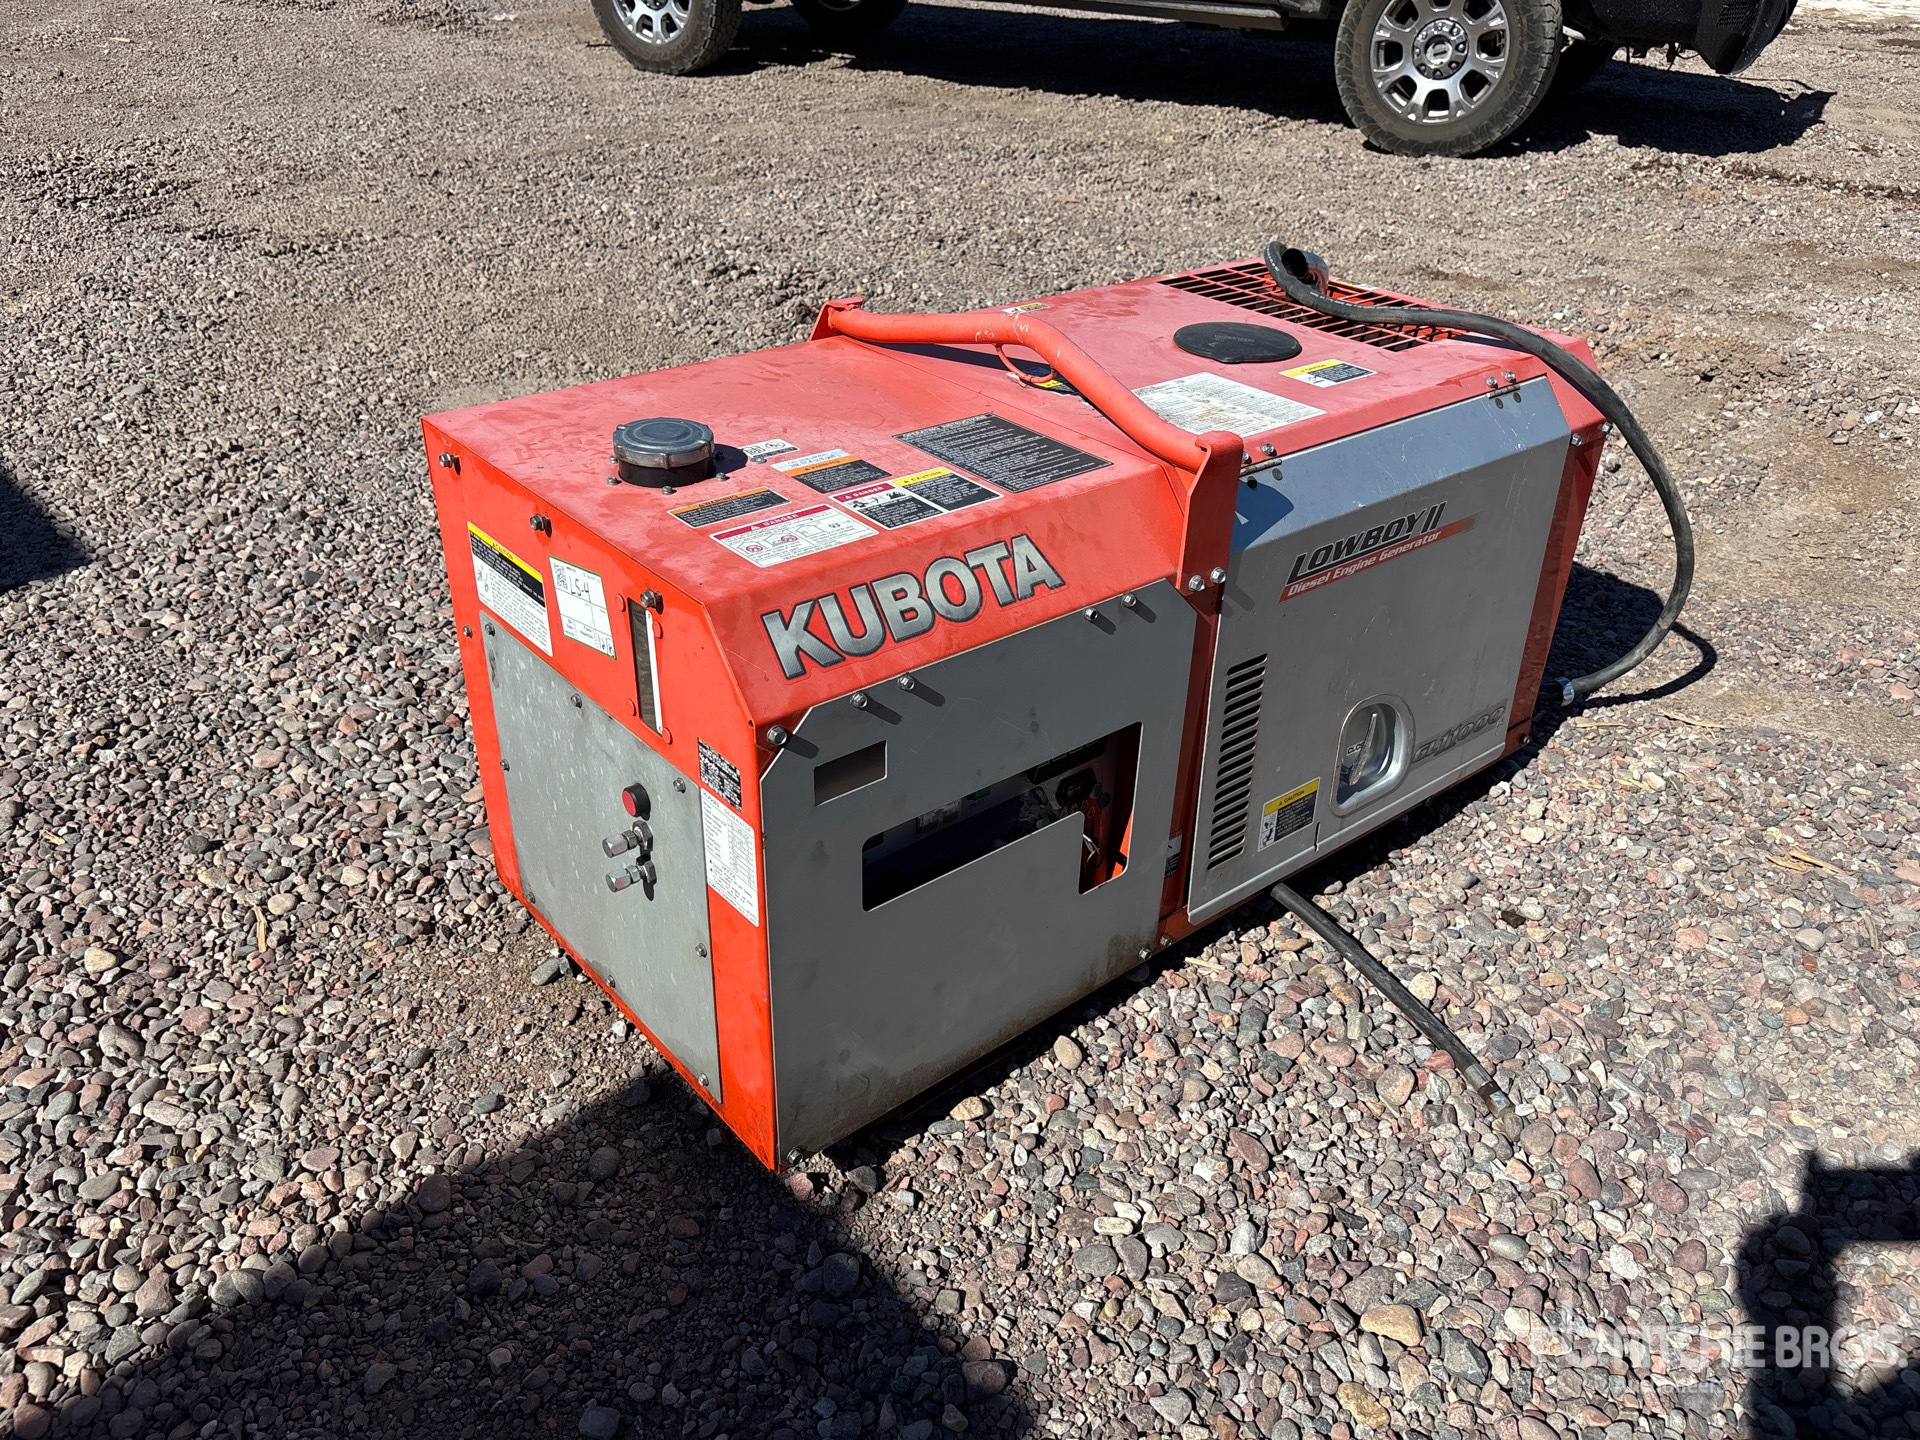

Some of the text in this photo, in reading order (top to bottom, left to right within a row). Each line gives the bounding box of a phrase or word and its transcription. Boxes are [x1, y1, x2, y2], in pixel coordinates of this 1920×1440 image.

[910, 470, 942, 483] CAUTION
[852, 485, 884, 498] DANGER
[705, 494, 739, 508] WARNING
[762, 513, 799, 527] DANGER
[1285, 501, 1447, 586] LOWBOY II
[1287, 531, 1441, 597] Diesel Engine Generator
[761, 533, 1066, 679] KUBOTA
[1412, 706, 1505, 763] GL11000
[1283, 789, 1305, 803] CAUTION
